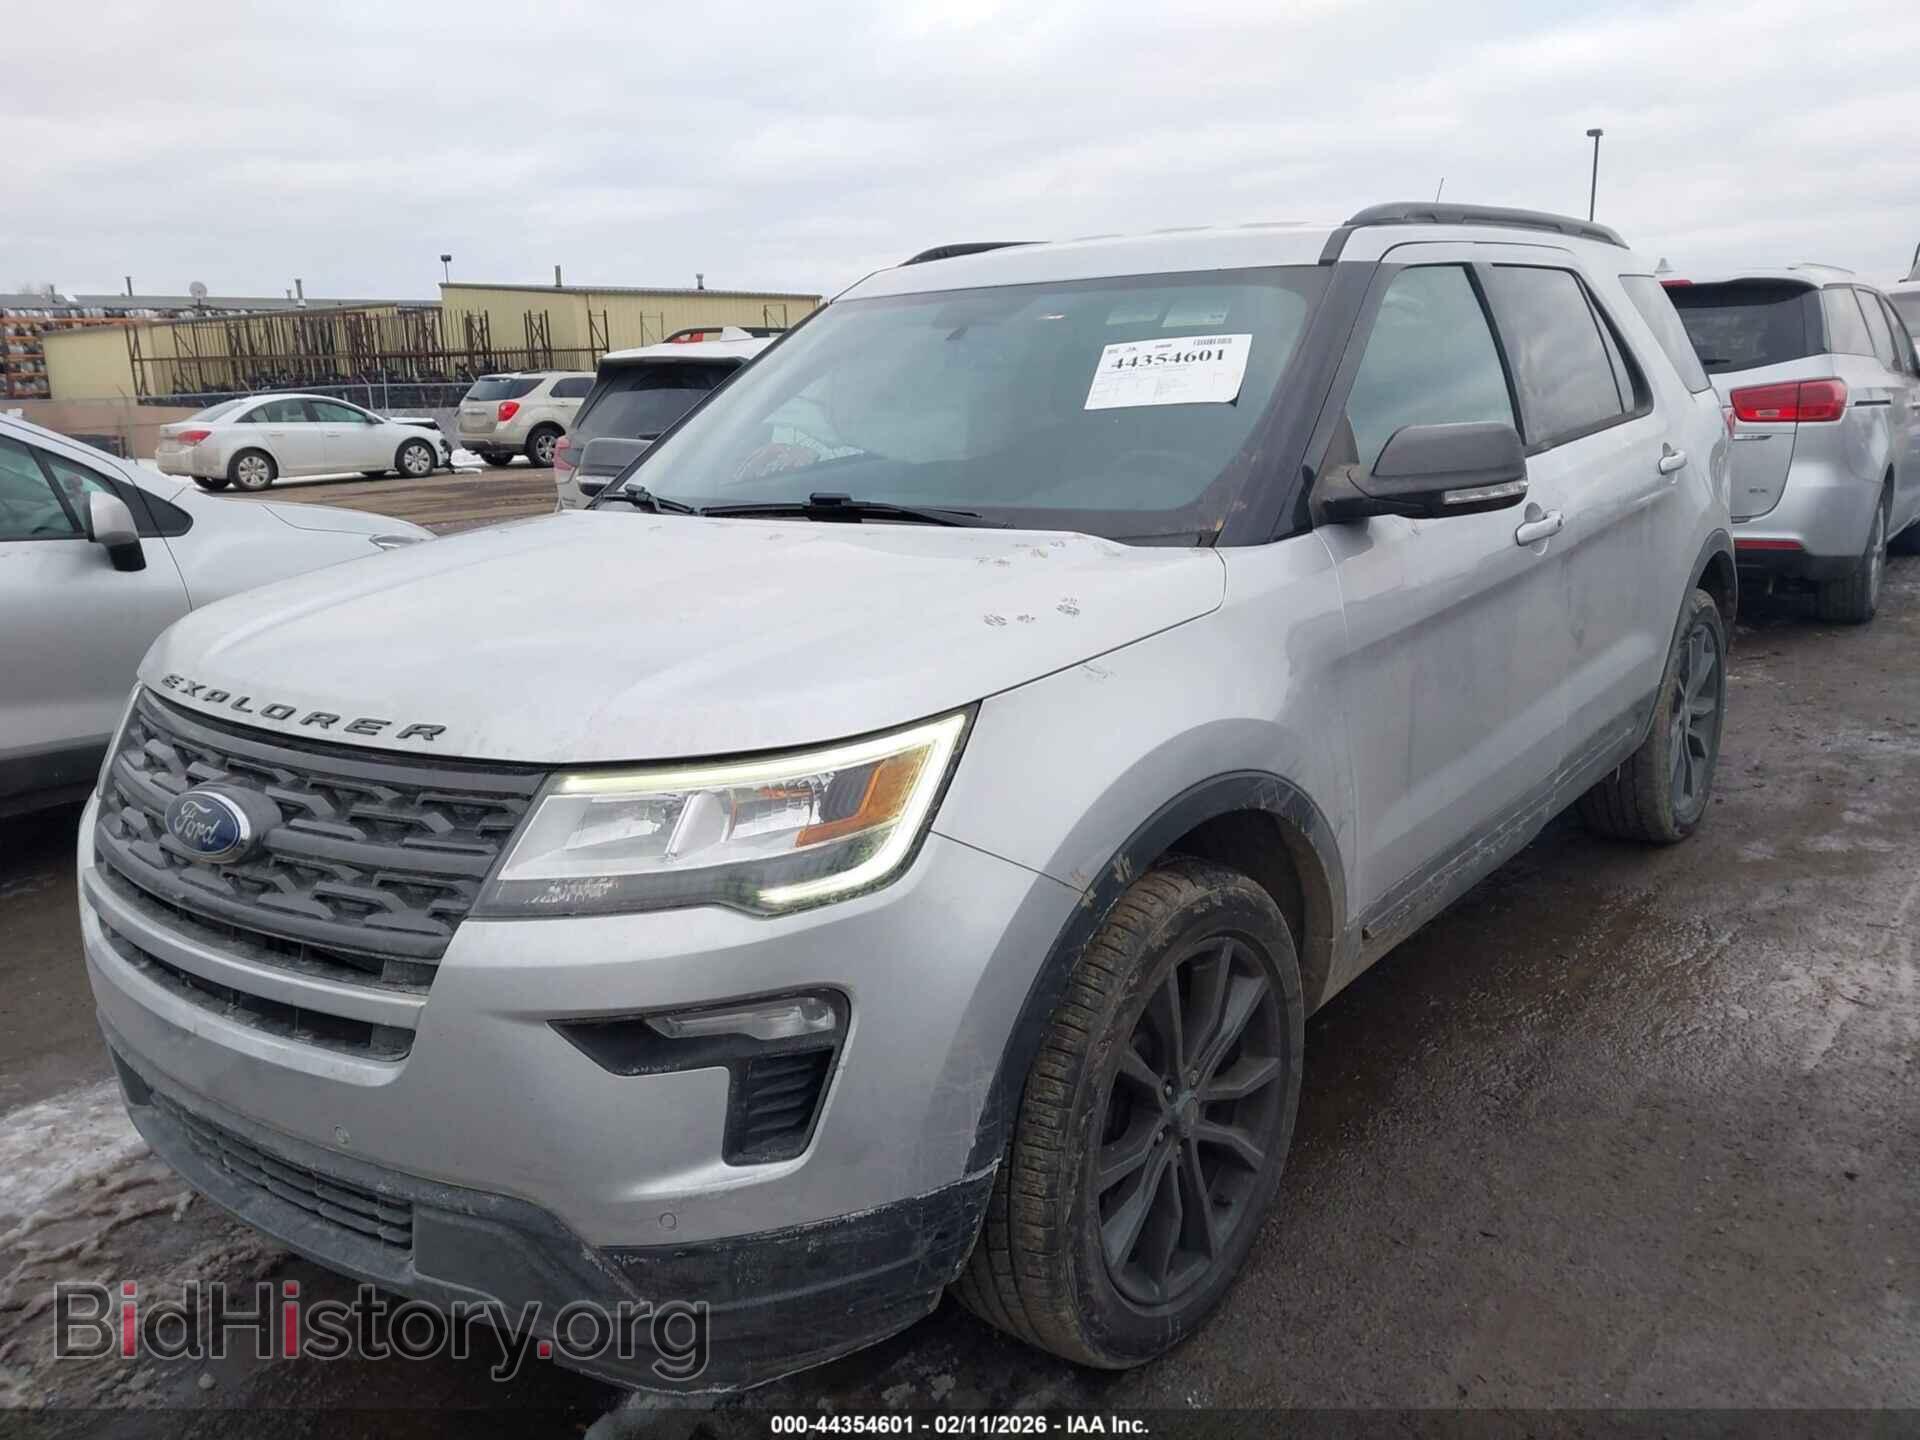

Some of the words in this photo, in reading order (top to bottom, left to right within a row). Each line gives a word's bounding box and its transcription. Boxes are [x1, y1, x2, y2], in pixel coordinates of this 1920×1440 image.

[1111, 349, 1225, 369] 44354601
[161, 673, 448, 741] EXPLORER
[173, 800, 221, 845] Ford
